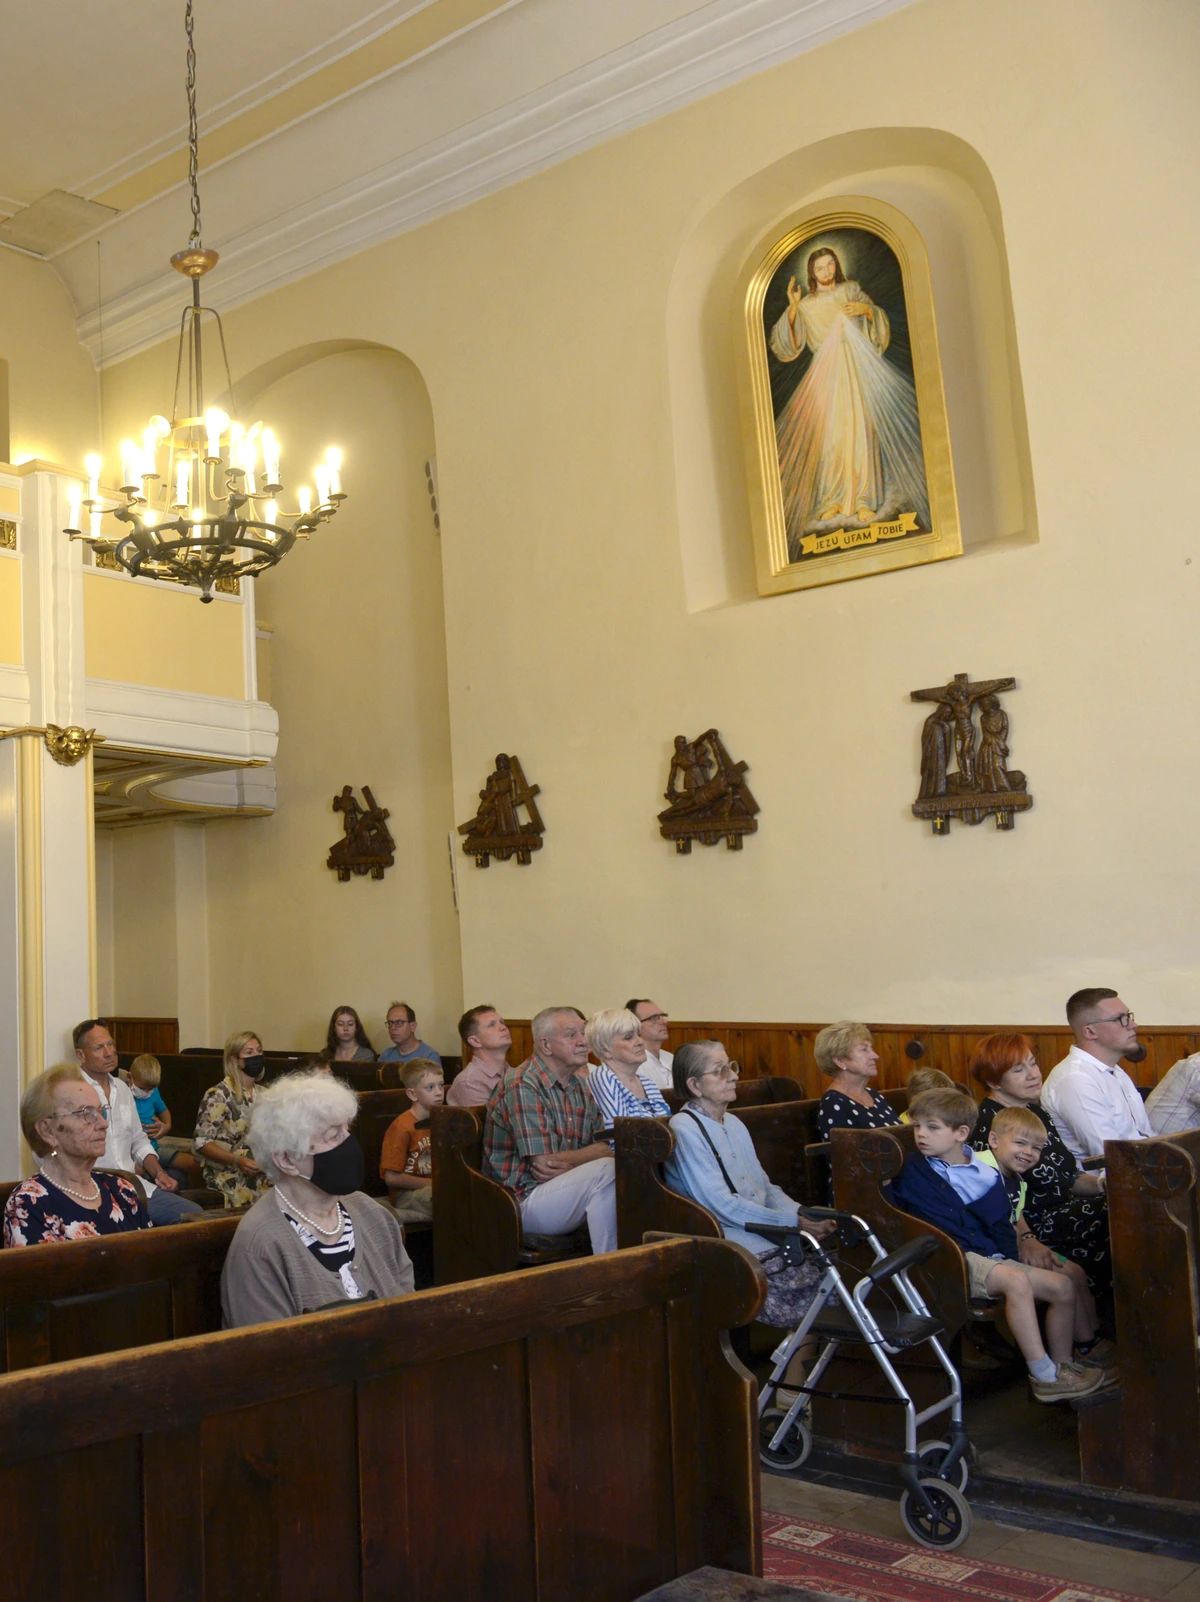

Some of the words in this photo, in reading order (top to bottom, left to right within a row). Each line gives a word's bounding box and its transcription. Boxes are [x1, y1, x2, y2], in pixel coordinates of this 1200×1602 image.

[816, 536, 839, 550] JEZU
[843, 531, 872, 545] UFAM
[878, 523, 904, 535] TOBIE
[996, 811, 1008, 824] XII
